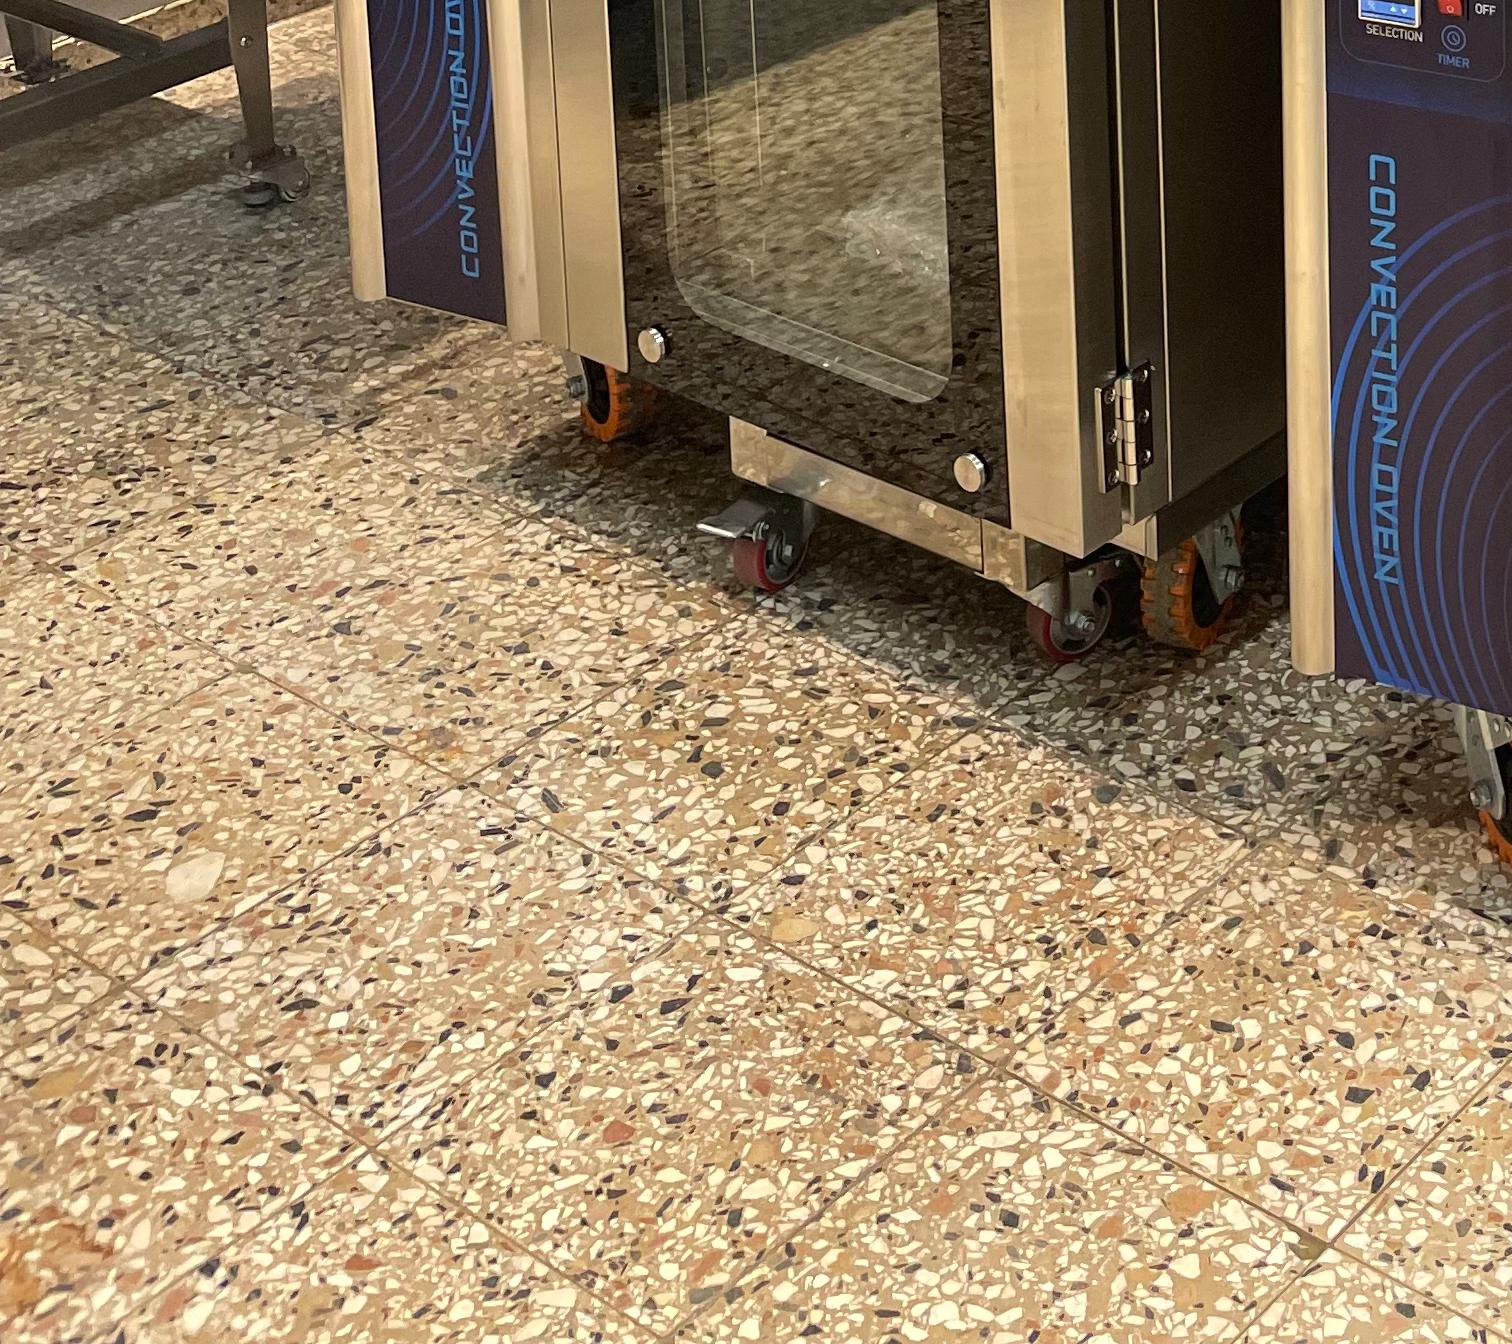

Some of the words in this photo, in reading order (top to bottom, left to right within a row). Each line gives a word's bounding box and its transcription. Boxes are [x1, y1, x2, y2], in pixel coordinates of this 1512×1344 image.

[1366, 23, 1424, 43] SELECTION
[1474, 2, 1496, 16] OFF
[1437, 52, 1470, 69] TIMER
[447, 48, 480, 279] CONVECTION
[1368, 153, 1398, 448] CONVECTION
[1372, 463, 1400, 586] OVEN
